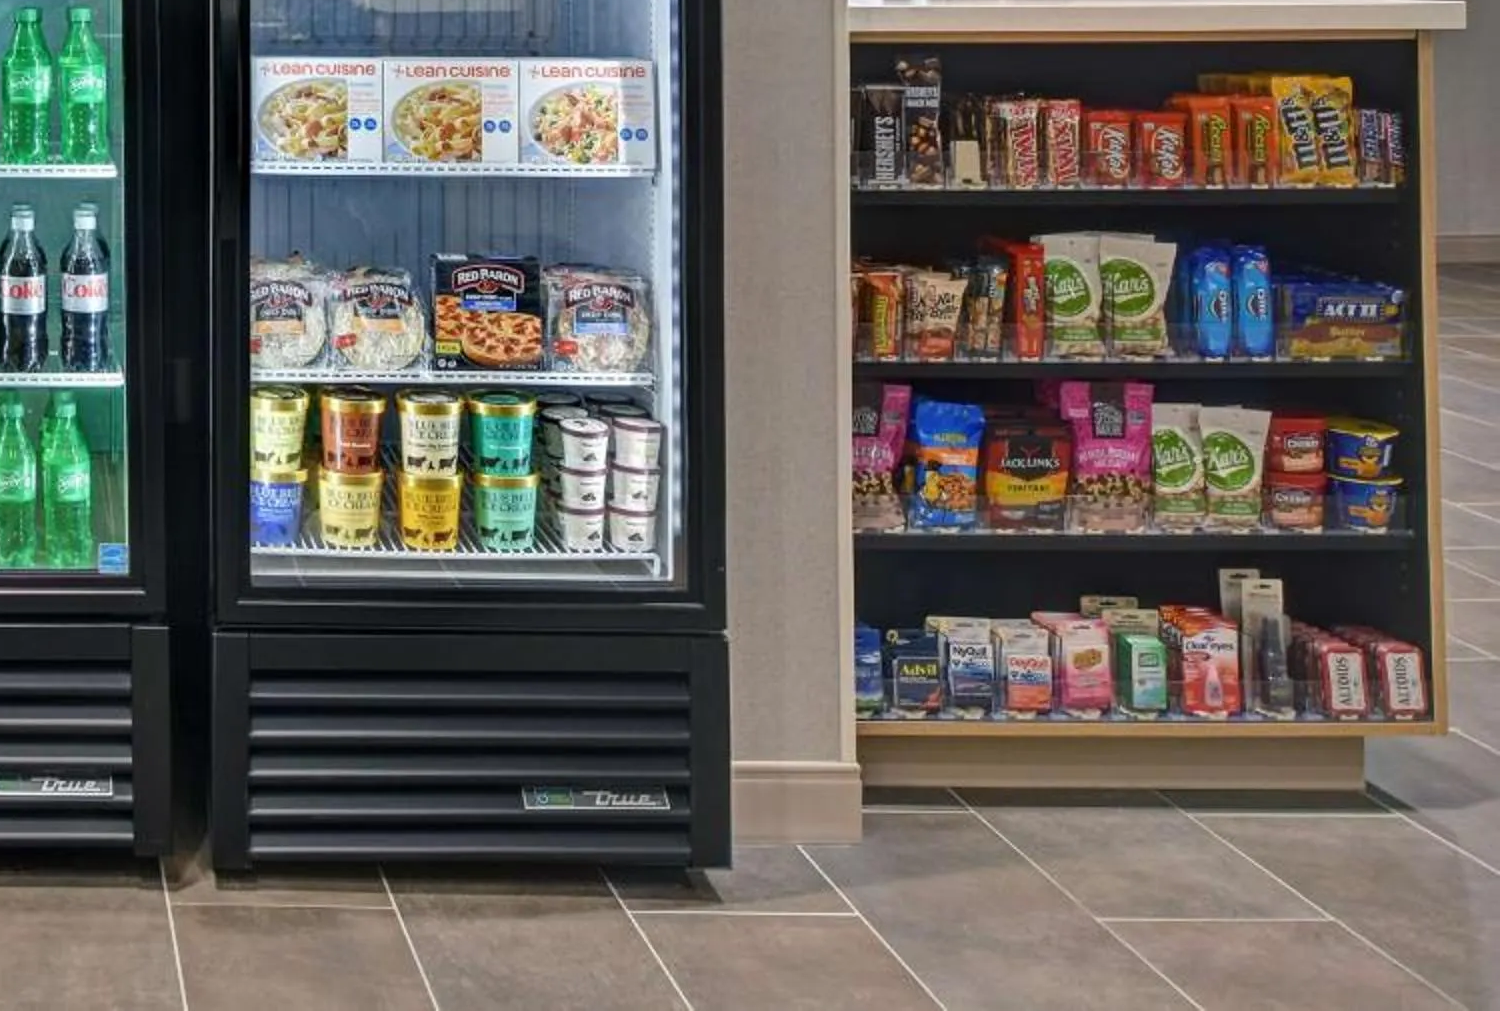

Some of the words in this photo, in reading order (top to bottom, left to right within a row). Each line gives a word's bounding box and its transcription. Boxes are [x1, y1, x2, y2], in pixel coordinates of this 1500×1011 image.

[457, 272, 479, 285] RED
[479, 268, 519, 285] BARON
[569, 286, 591, 301] RED
[1323, 303, 1354, 317] ACT
[1357, 303, 1378, 317] II
[1000, 457, 1026, 469] JACK
[952, 645, 987, 657] NyQuil
[1211, 641, 1234, 653] eyes
[900, 663, 938, 676] Advil
[31, 777, 102, 792] True
[582, 790, 660, 807] True
